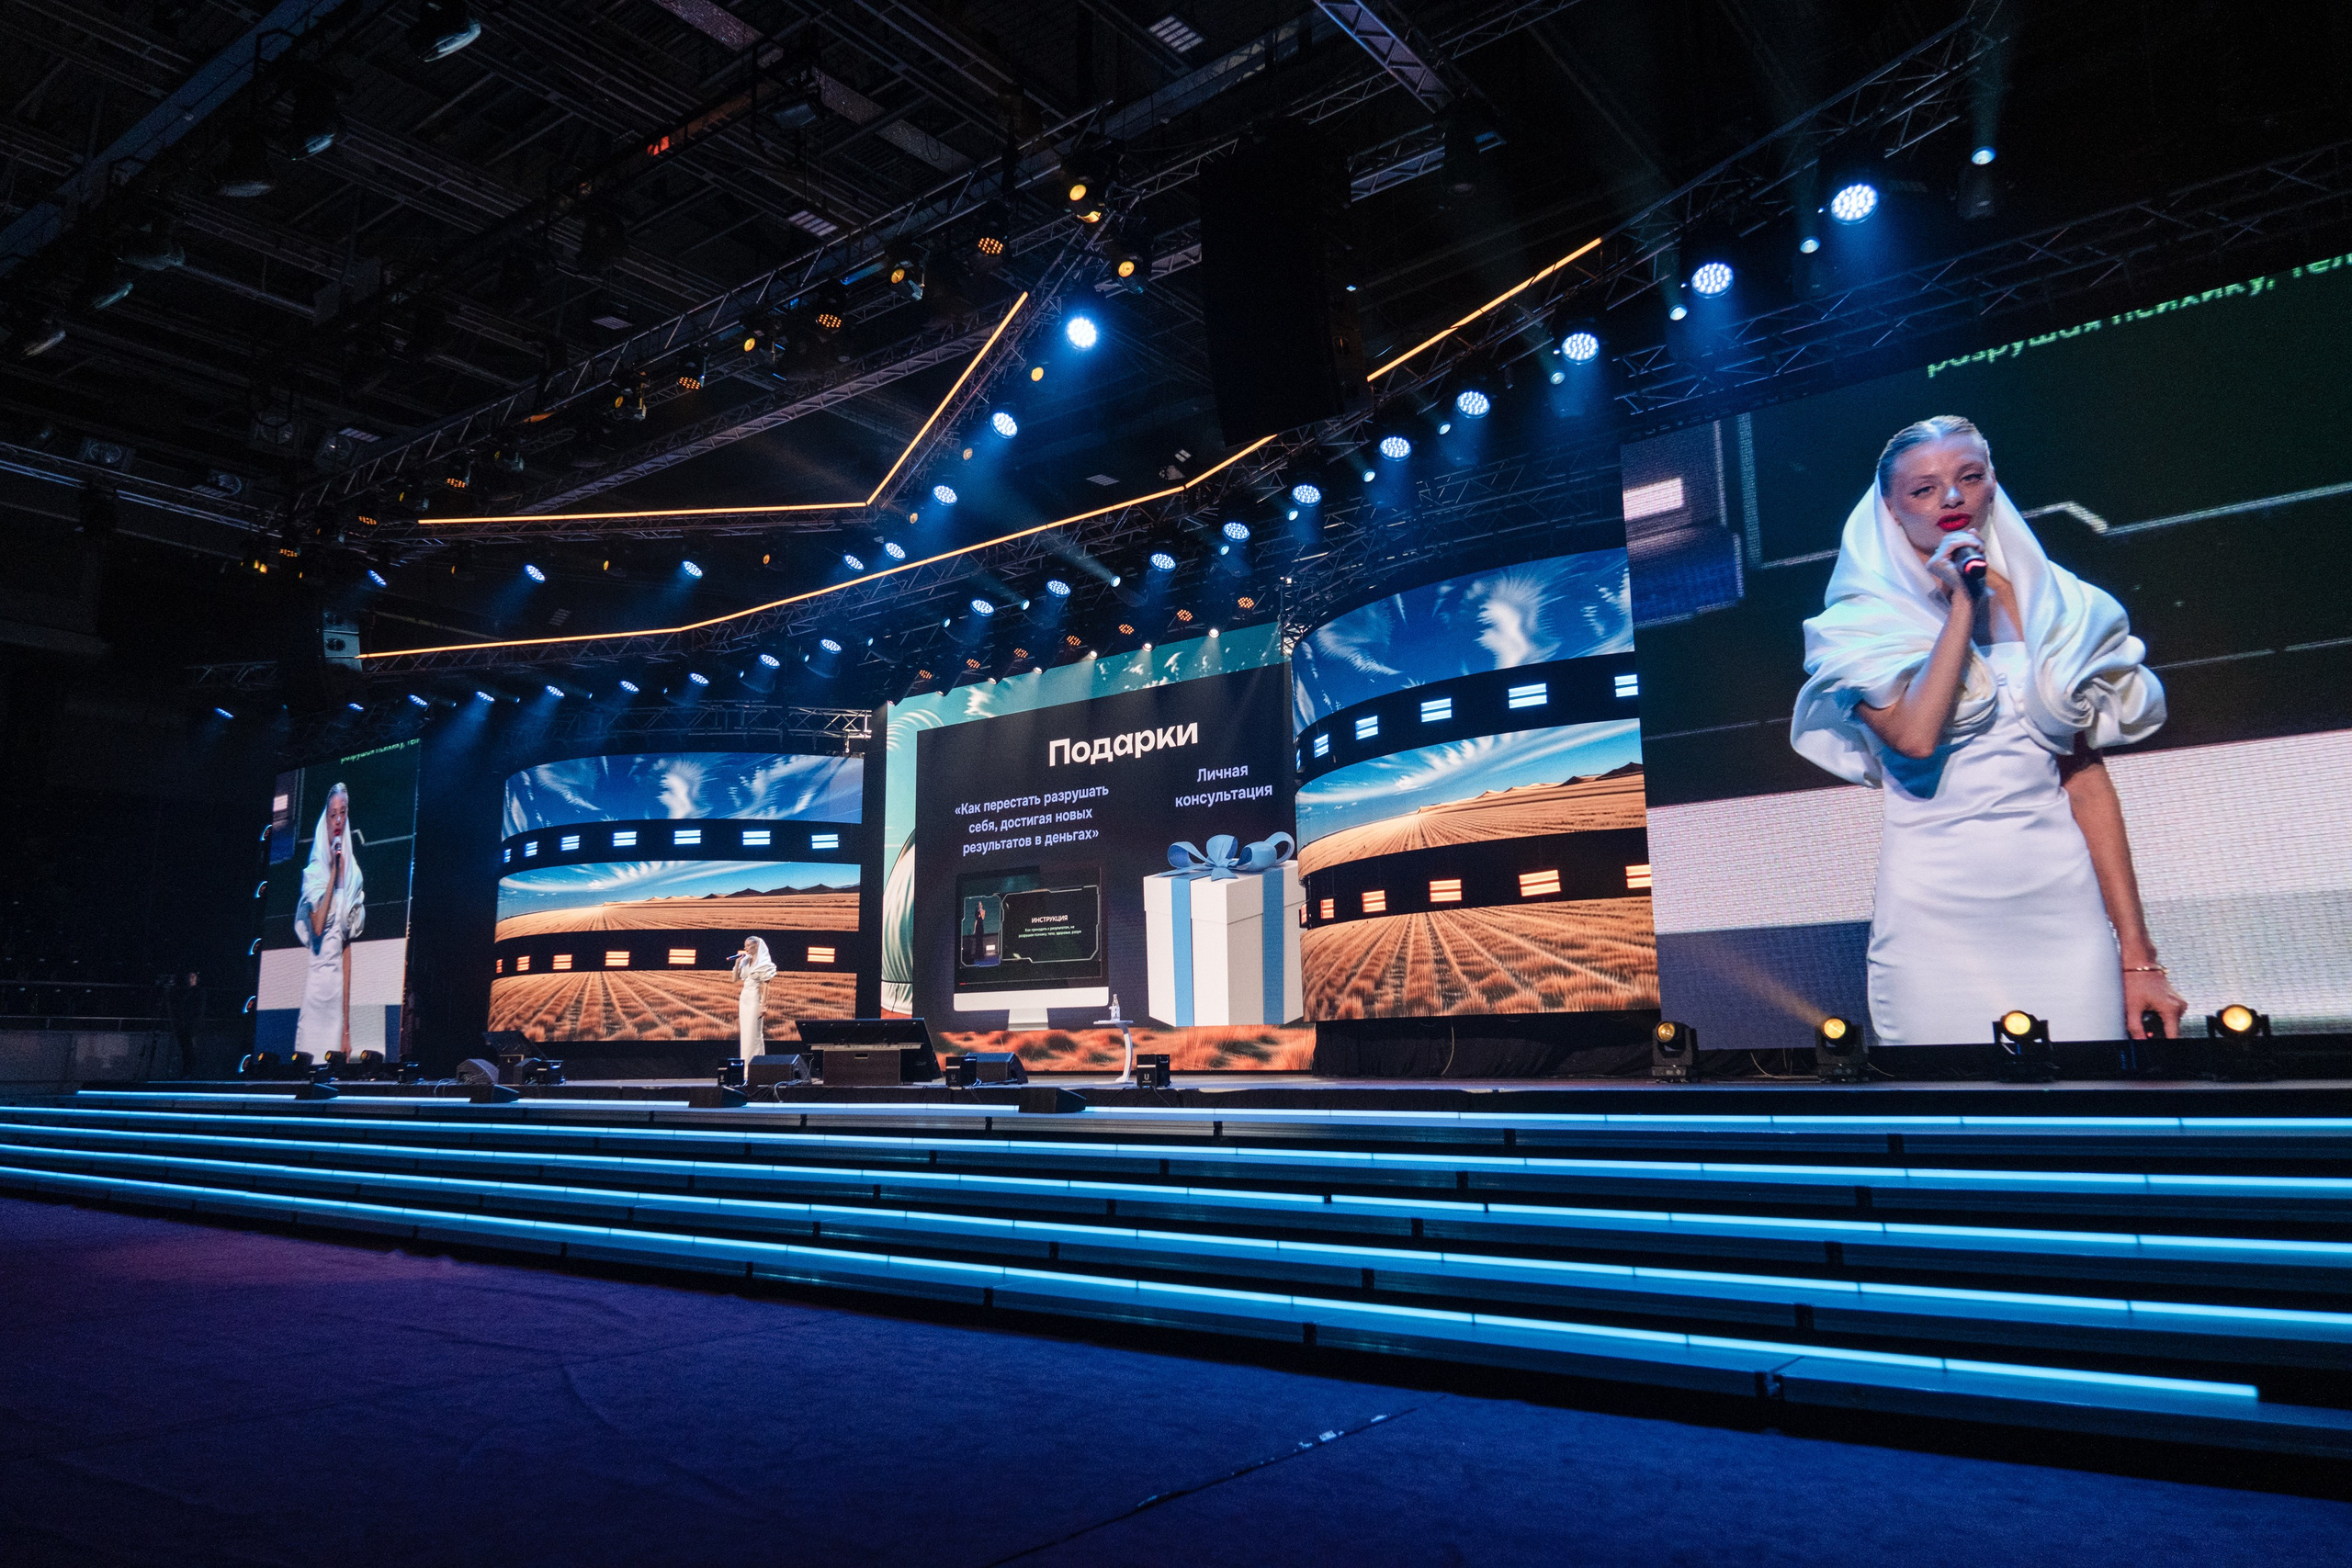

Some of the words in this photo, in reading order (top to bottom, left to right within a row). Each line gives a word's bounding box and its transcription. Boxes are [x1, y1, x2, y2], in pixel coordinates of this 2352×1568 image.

[1049, 722, 1198, 767] Подарки
[1197, 765, 1249, 783] Личная
[955, 803, 981, 816] «Как
[983, 795, 1041, 813] перестать
[1044, 785, 1110, 807] разрушать
[1175, 784, 1273, 807] консультация
[968, 819, 999, 834] себя,
[1000, 812, 1053, 831] достигая
[1056, 808, 1093, 823] новых
[963, 835, 1033, 856] результатов
[1035, 835, 1042, 845] в
[1045, 829, 1100, 847] деньгах»
[1031, 914, 1069, 923] ИНСТРУКЦИЯ
